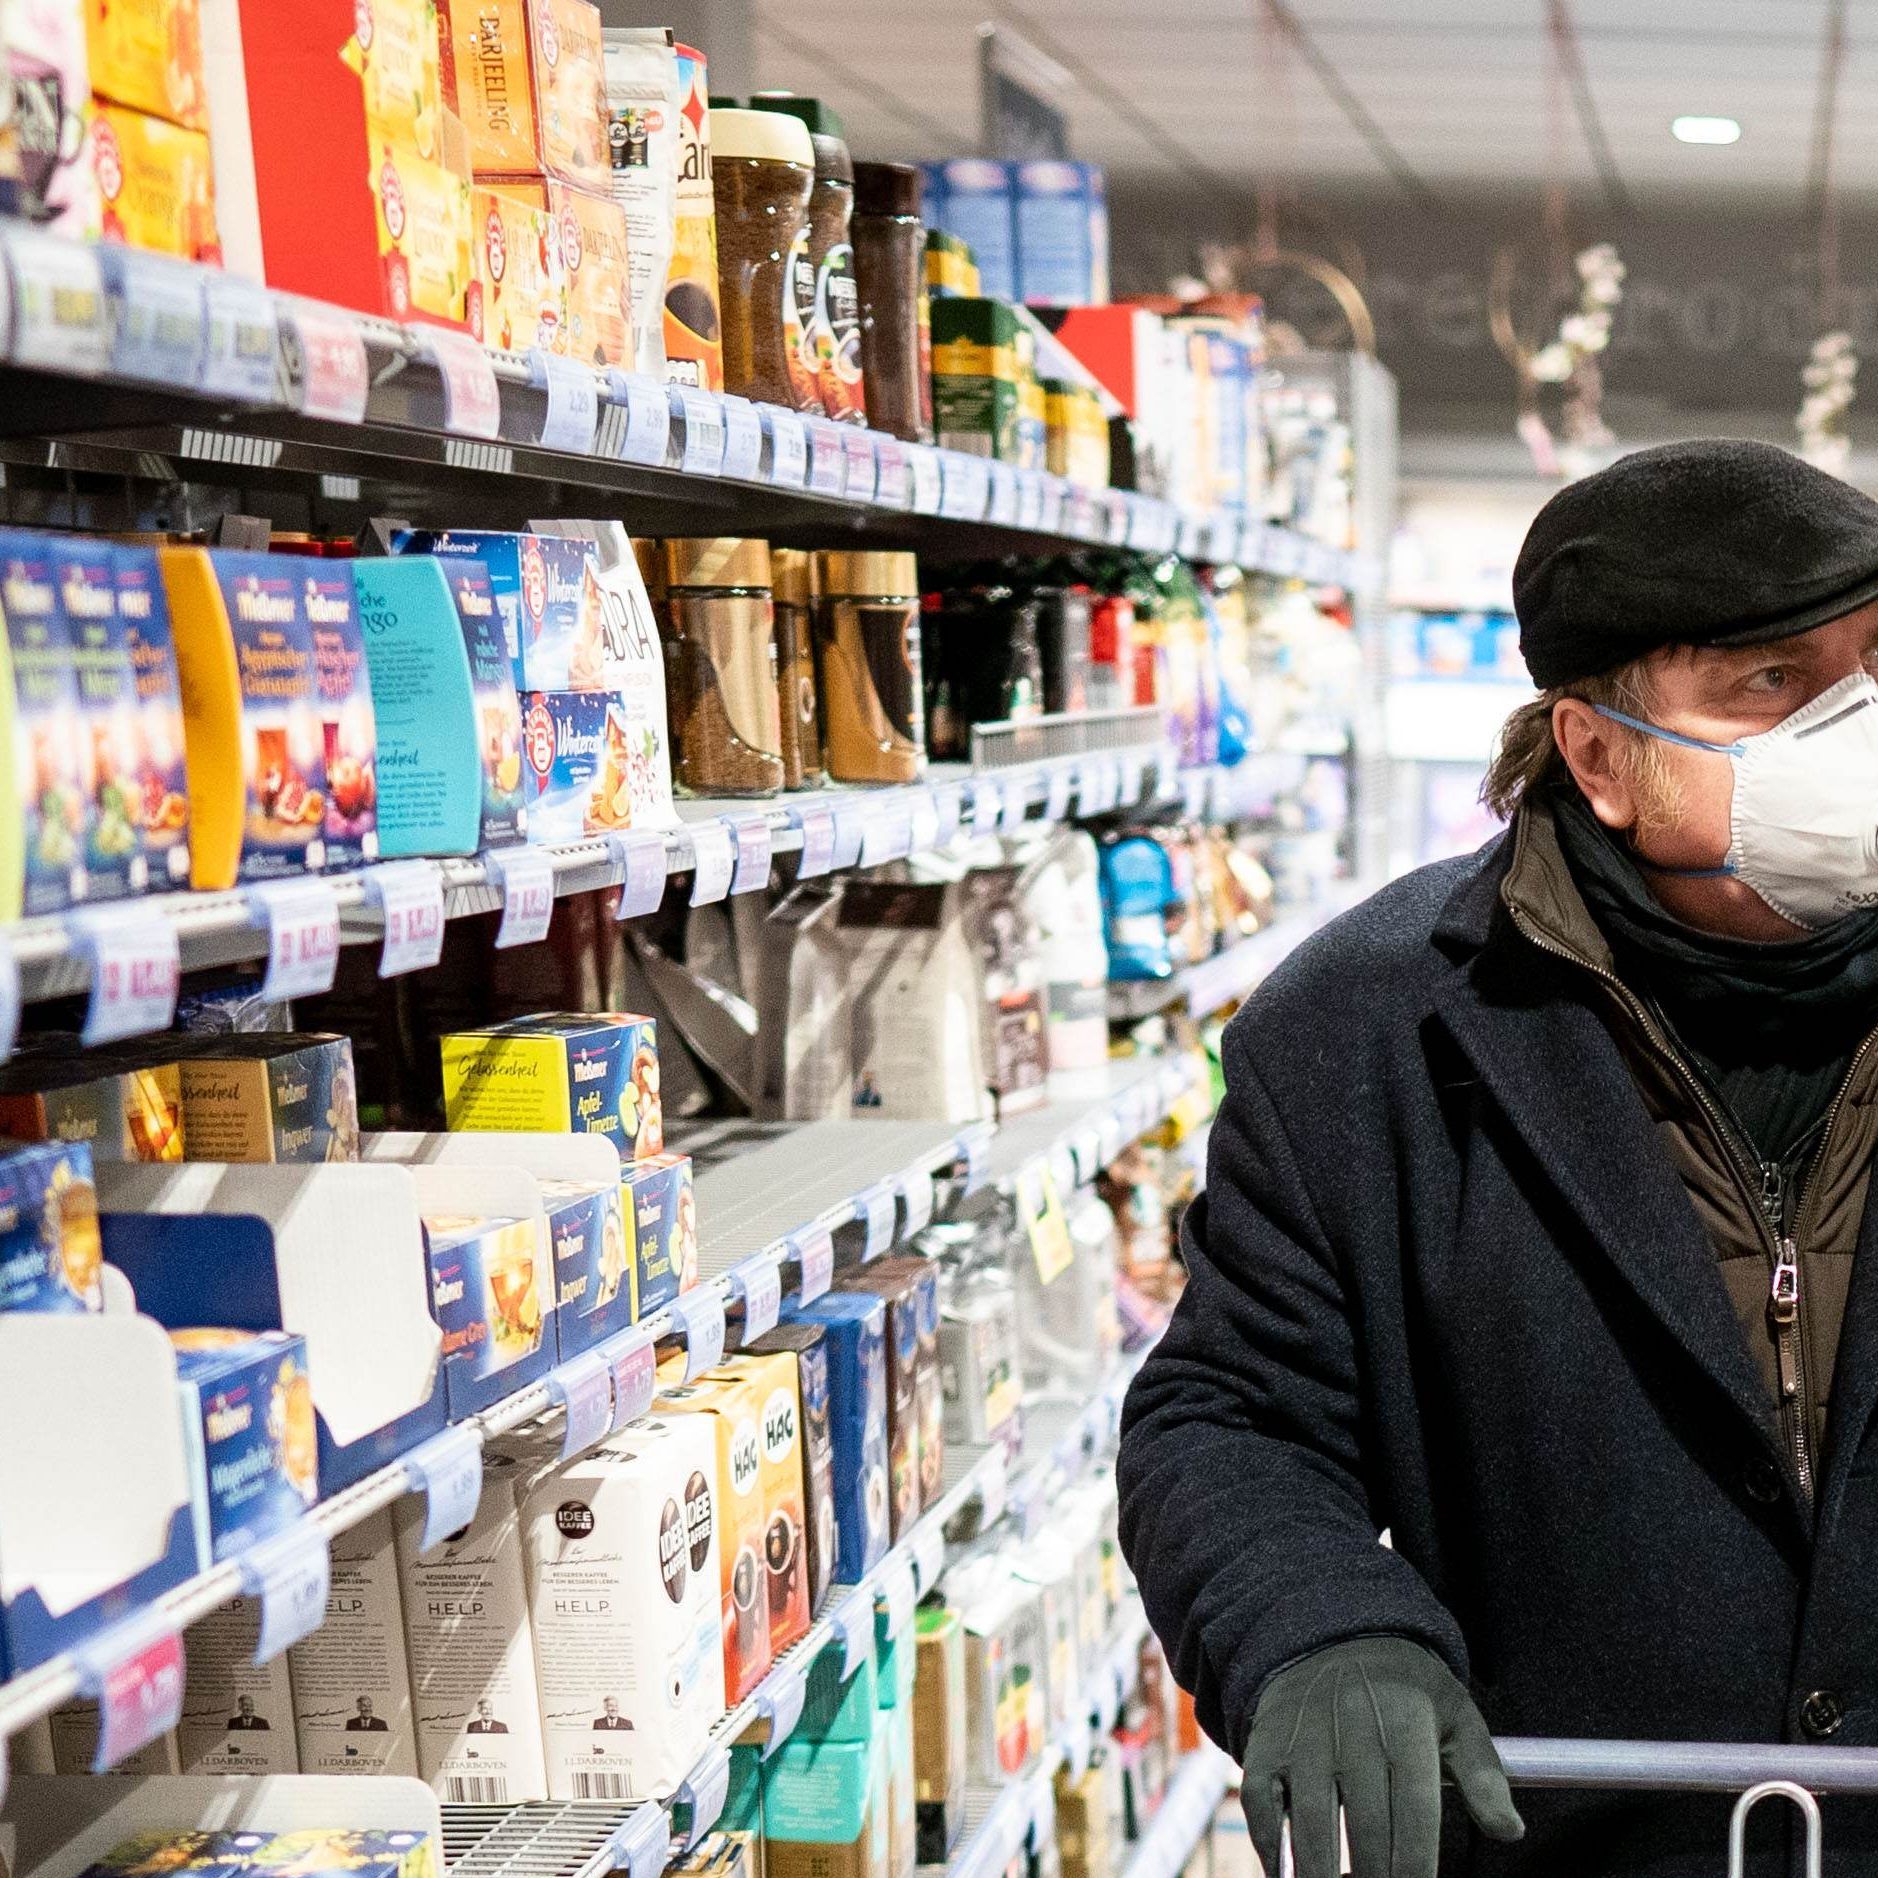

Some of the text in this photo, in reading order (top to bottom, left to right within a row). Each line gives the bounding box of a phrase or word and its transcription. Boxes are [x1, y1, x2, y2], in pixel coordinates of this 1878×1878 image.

[478, 16, 511, 134] DARJEELING
[456, 1055, 540, 1079] Gelassenheit
[574, 1060, 608, 1083] Meßmer
[578, 1091, 603, 1115] Apfel-
[560, 1276, 588, 1303] Ingwer
[766, 1406, 794, 1443] HAG
[734, 1437, 757, 1483] HAG
[559, 1510, 592, 1523] IDEE
[559, 1521, 592, 1531] KAFFEE
[660, 1518, 685, 1558] IDEE
[326, 1600, 366, 1613] E.L.P.
[428, 1602, 486, 1616] H.E.L.P.
[555, 1600, 613, 1614] H.E.L.P.
